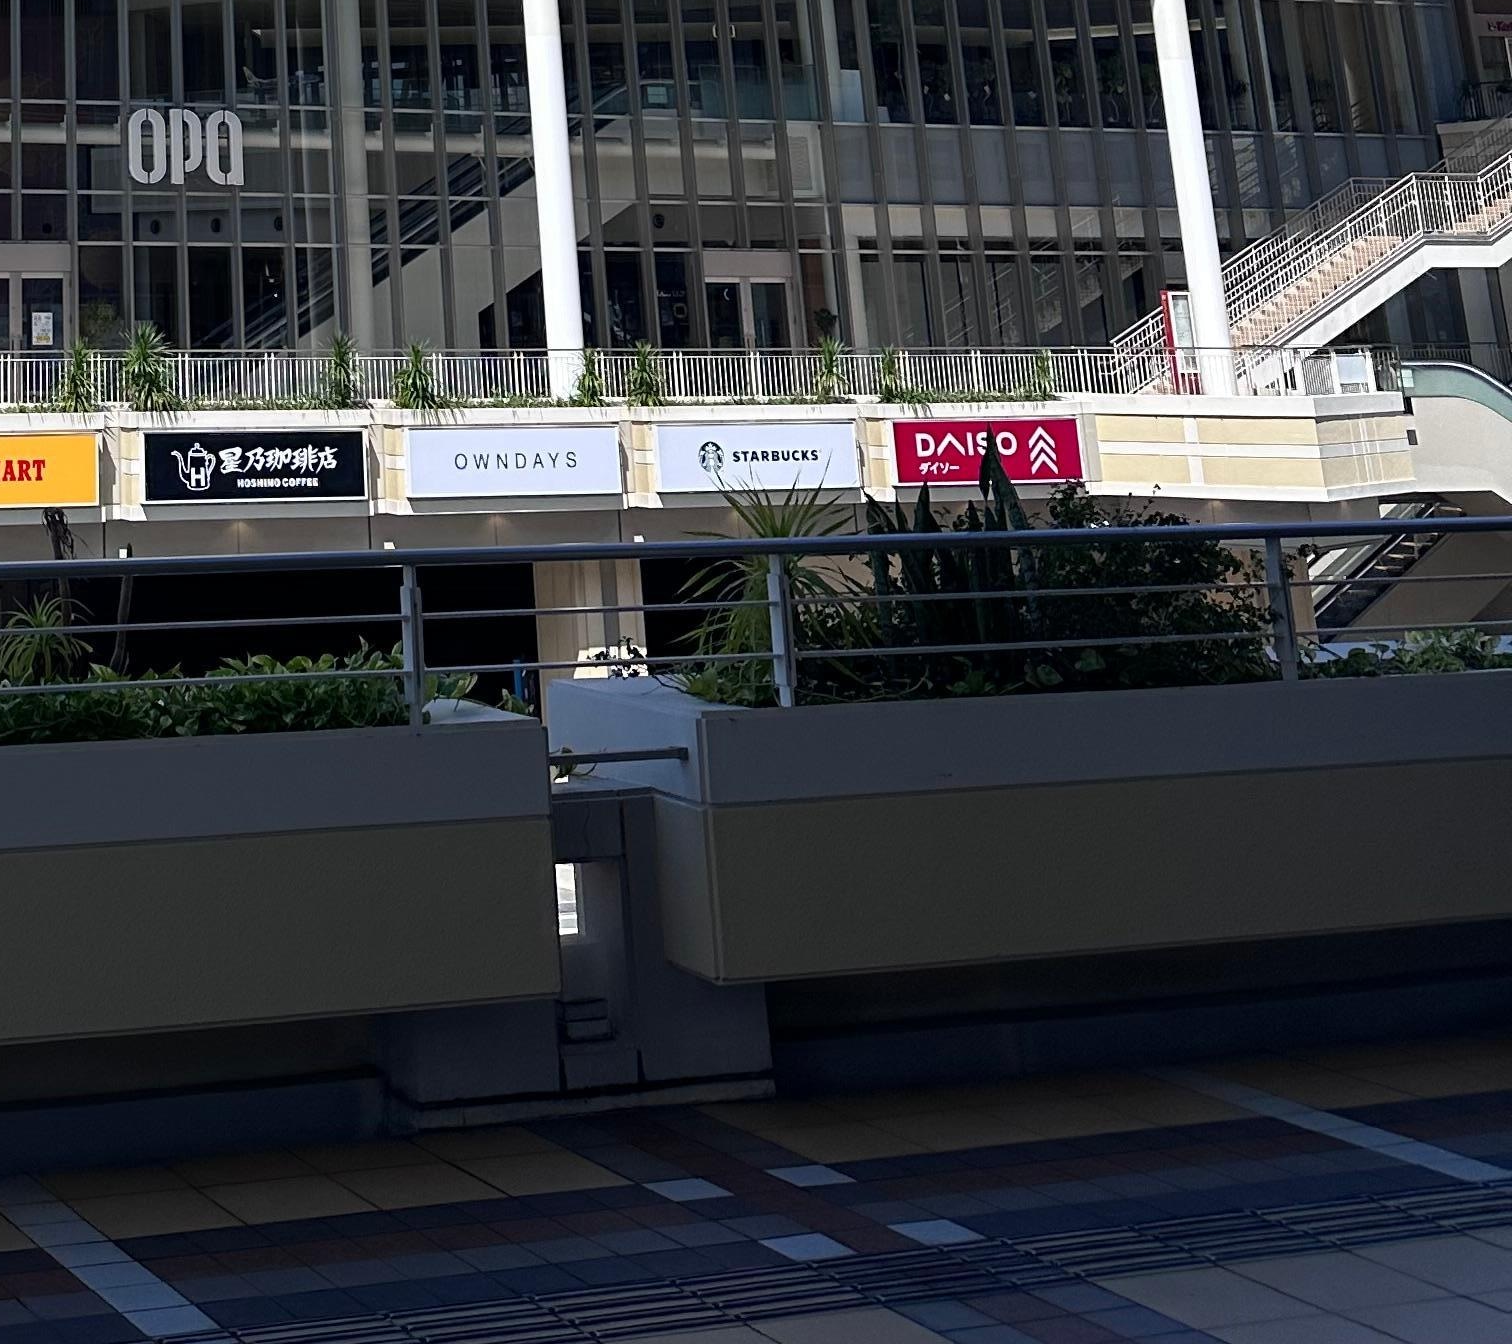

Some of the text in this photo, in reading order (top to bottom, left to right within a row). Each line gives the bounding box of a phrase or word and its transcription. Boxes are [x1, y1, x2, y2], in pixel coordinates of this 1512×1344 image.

[915, 431, 1018, 458] DAISO
[218, 444, 339, 475] 星乃珈琲店
[454, 451, 577, 470] OWNDAYS
[732, 449, 819, 463] STARBUCKS
[919, 461, 960, 475] ダイソー
[236, 477, 319, 489] HOSHINO COFFEE
